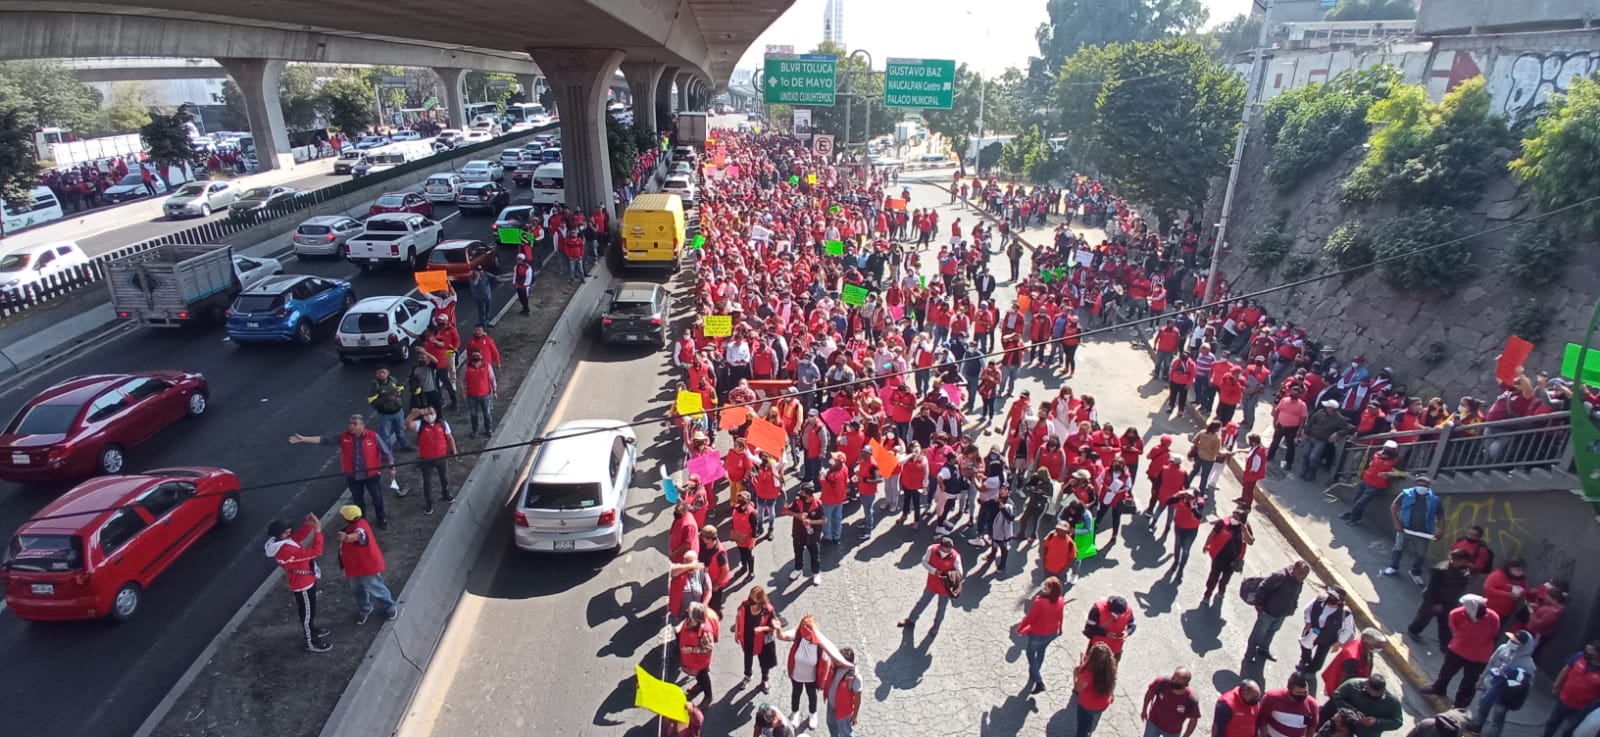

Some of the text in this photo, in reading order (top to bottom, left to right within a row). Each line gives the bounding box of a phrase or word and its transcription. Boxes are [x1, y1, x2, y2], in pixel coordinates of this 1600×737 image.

[781, 63, 832, 73] BLVR TOLUCA
[889, 66, 942, 77] GUSTAVO BAZ
[792, 77, 803, 87] DE
[806, 78, 832, 88] MAYO
[888, 80, 941, 91] NAUCALPAN Centro
[780, 92, 799, 101] UNIDAD
[887, 95, 939, 105] PALACIO MUNICIPAL
[819, 140, 828, 151] E
